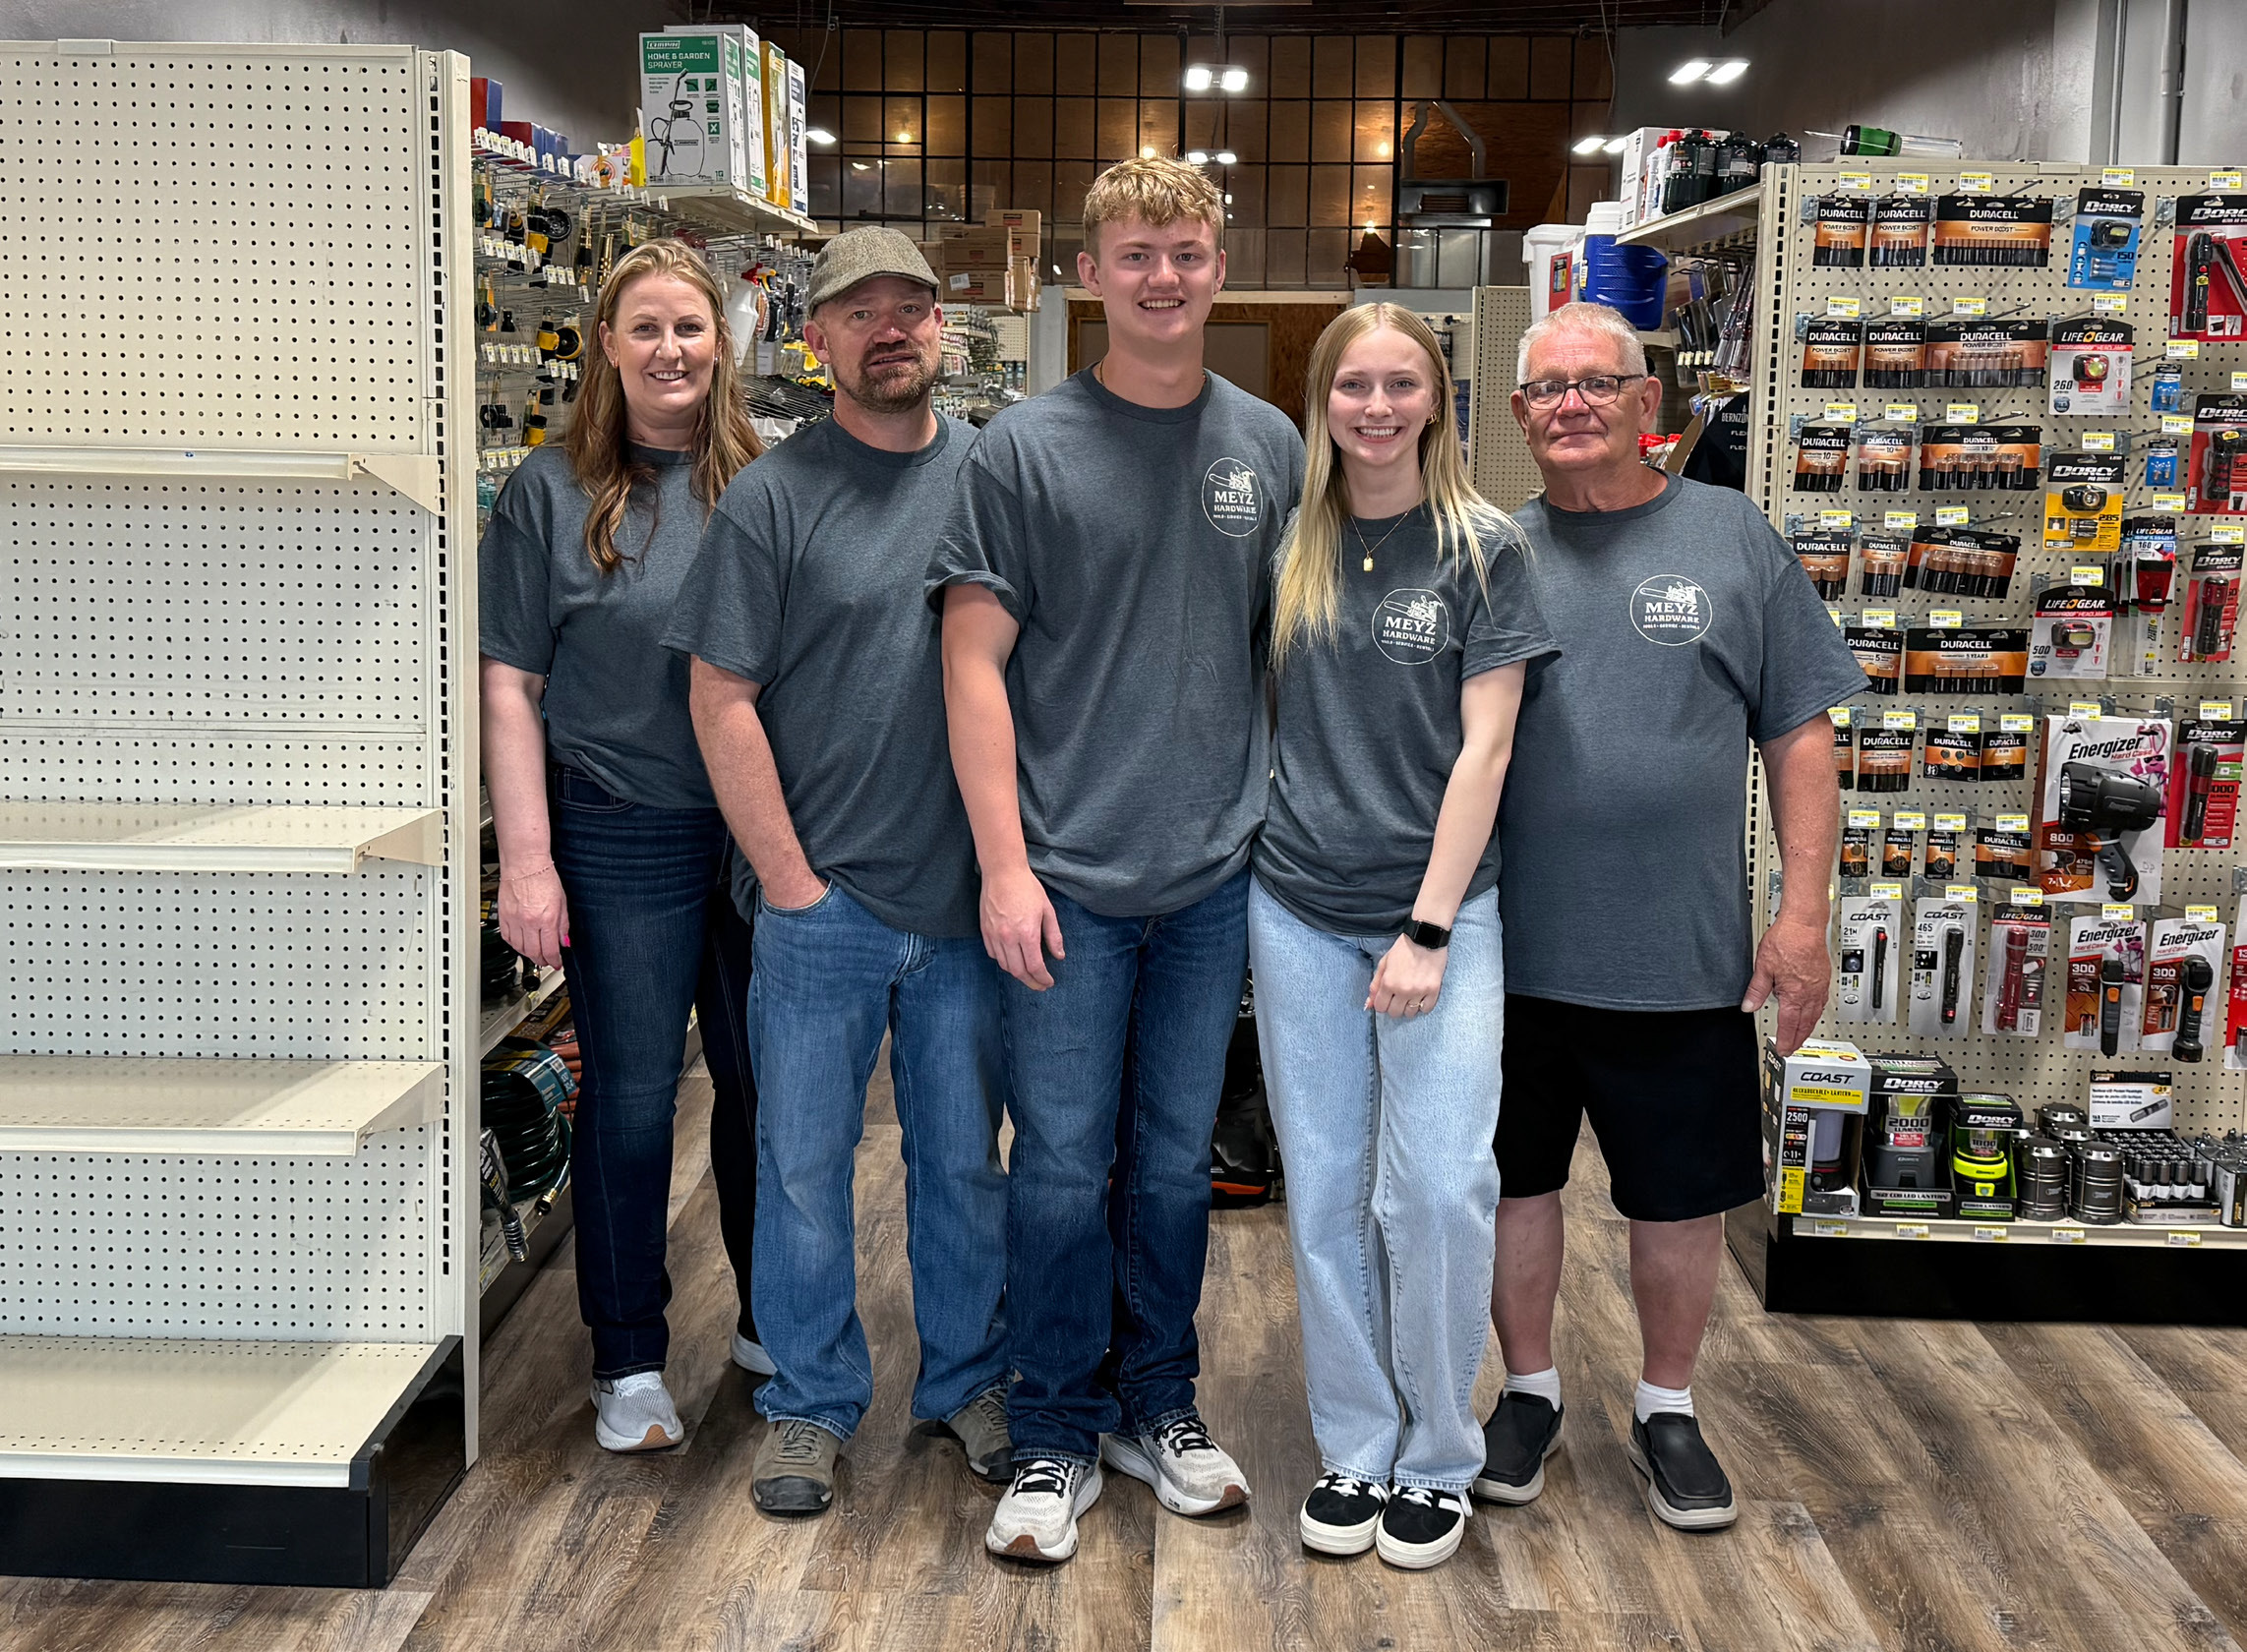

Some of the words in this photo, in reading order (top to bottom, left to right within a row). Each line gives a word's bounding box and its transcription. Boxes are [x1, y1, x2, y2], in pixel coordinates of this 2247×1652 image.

[2084, 201, 2137, 213] DORCY
[1820, 209, 1864, 218] DURACELL
[1878, 209, 1925, 218] DURACELL
[1970, 209, 2018, 219] DURACELL
[2190, 207, 2247, 220] DORC
[1808, 332, 1858, 341] DURACELL
[1869, 331, 1922, 341] DURACELL
[1960, 331, 2012, 341] DURACELL
[2061, 332, 2083, 342] LIFE
[2095, 332, 2124, 342] GEAR
[2053, 381, 2073, 390] 260
[2198, 407, 2247, 418] DORC
[1803, 438, 1845, 447] DURACELL
[2053, 465, 2118, 477] DORCY
[1214, 491, 1255, 505] MEYZ
[1213, 504, 1257, 514] HARDWARE
[1797, 543, 1847, 552] DURACELL
[1869, 542, 1902, 551] DURACELL
[1950, 540, 1981, 549] DURACELL
[1645, 602, 1699, 616] MEYZ
[2045, 599, 2066, 609] LIFE
[2077, 599, 2105, 609] GEAR
[1644, 615, 1700, 623] HARDWARE
[1385, 616, 1437, 635] MEYZ
[1383, 630, 1436, 645] HARDWARE
[1848, 639, 1899, 650] DURACELL
[1940, 640, 1992, 649] DURACELL
[2033, 645, 2050, 655] 500
[1863, 738, 1911, 746] DURACELL
[1934, 738, 1974, 748] DURACELL
[2068, 737, 2145, 760] Energizer
[2212, 784, 2234, 794] 000
[1984, 836, 2024, 847] DURACELL
[2050, 833, 2074, 843] 800
[1850, 913, 1891, 921] COAST
[1923, 911, 1968, 919] COAST
[2030, 929, 2046, 938] 300
[2077, 925, 2139, 944] Energizer
[2159, 929, 2219, 947] Energizer
[2072, 964, 2096, 974] 300
[2154, 968, 2176, 977] 300
[1767, 1051, 1782, 1072] COAST
[1801, 1072, 1855, 1085] COAST
[1883, 1078, 1945, 1090] DORCY
[1787, 1111, 1808, 1123] 2500
[1968, 1114, 2017, 1126] DORCY
[1888, 1118, 1929, 1128] 2000
